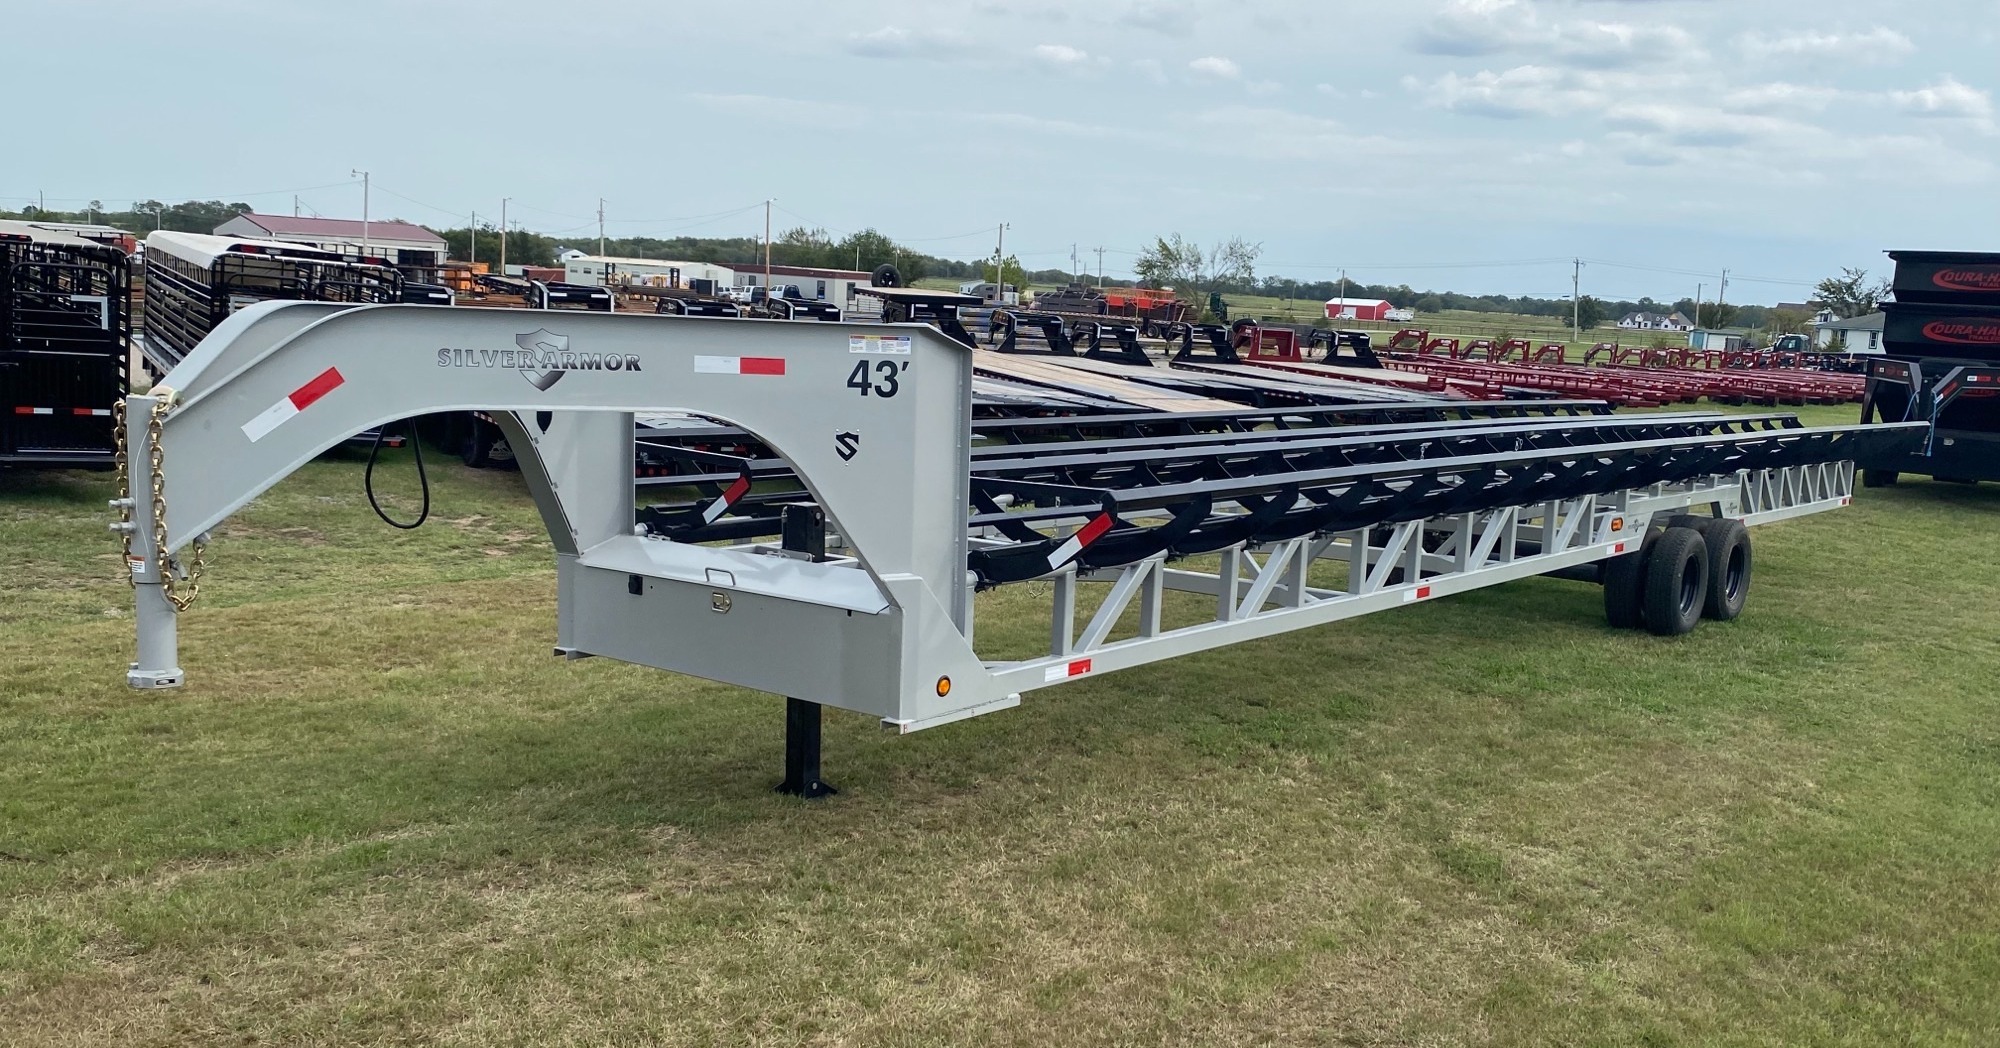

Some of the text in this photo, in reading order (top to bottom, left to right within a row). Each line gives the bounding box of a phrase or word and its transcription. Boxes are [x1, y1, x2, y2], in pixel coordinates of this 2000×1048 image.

[1944, 271, 2000, 283] DURA-H
[437, 348, 642, 372] SILVER ARMOR
